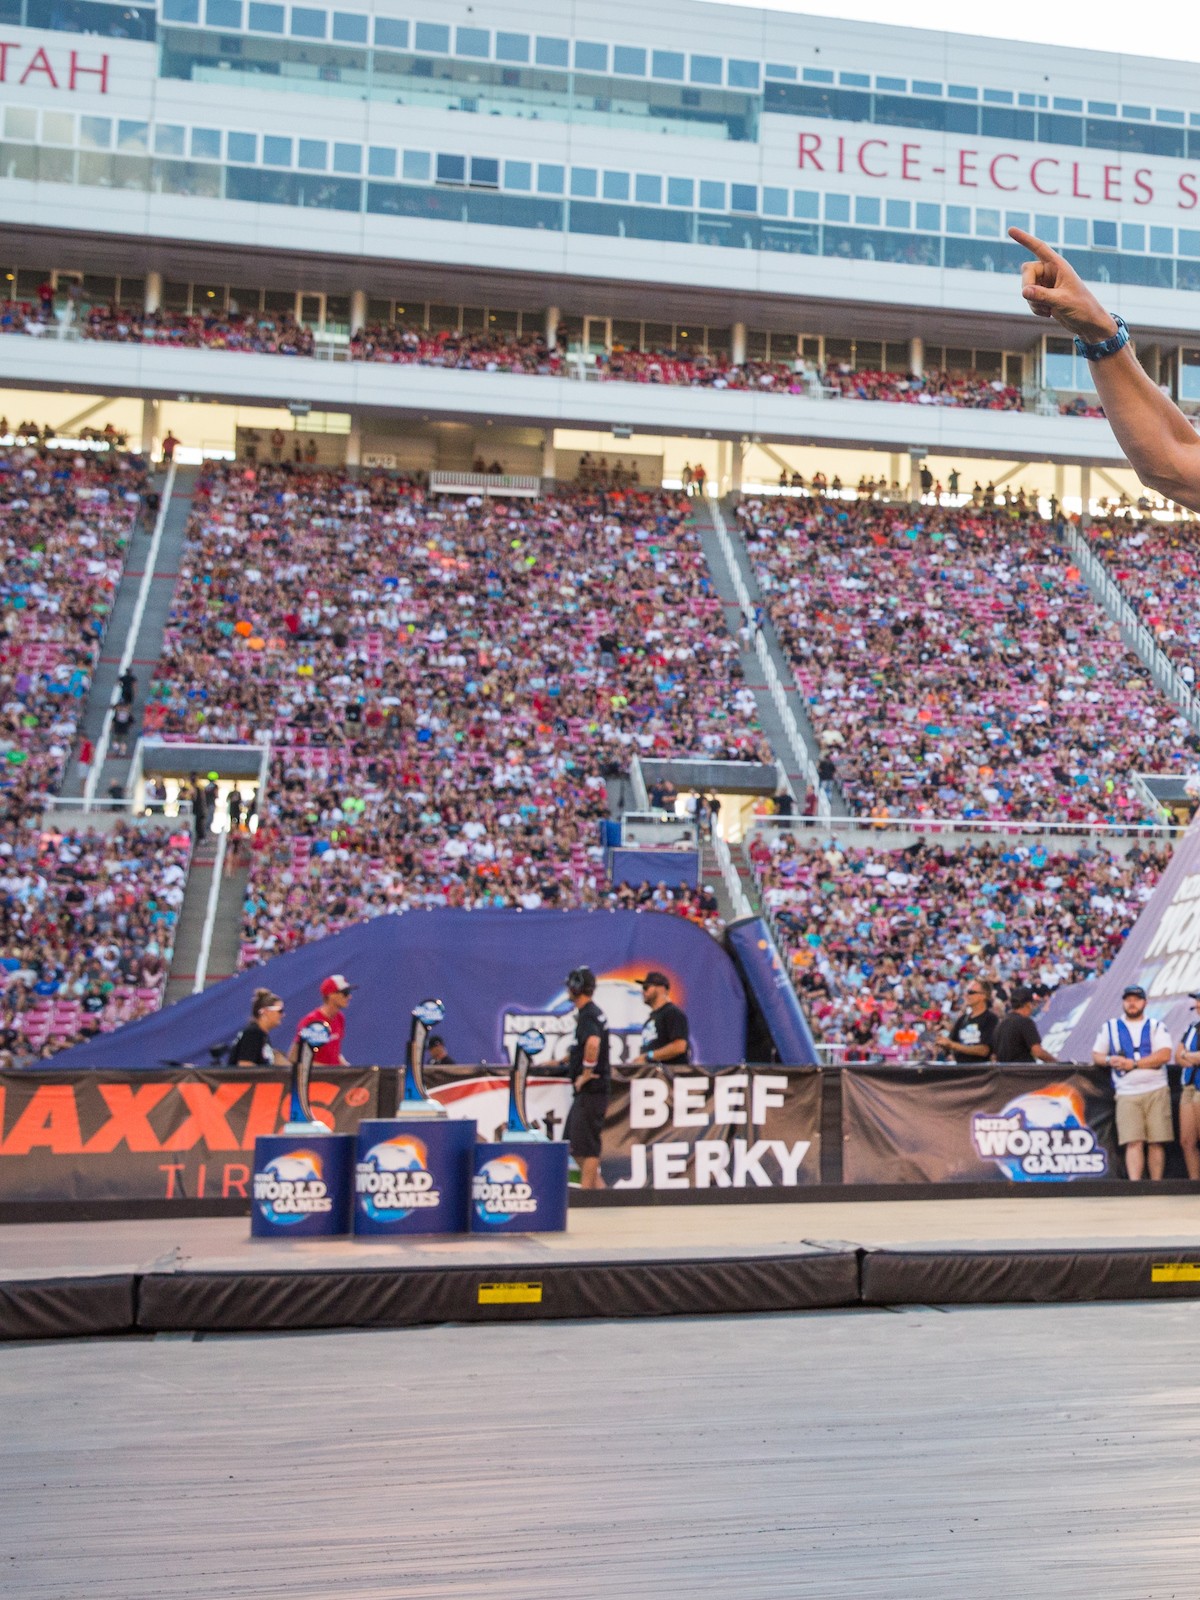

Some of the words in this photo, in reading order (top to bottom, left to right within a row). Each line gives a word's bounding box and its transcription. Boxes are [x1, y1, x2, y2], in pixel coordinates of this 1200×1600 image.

[0, 42, 109, 95] TAH
[797, 132, 1155, 206] RICE-ECCLES
[630, 1073, 789, 1129] BEEF
[0, 1082, 341, 1155] AXXIS
[974, 1129, 1094, 1156] WORLD
[612, 1138, 811, 1190] JERKY
[1022, 1153, 1105, 1174] GAMES
[159, 1163, 250, 1200] TIR
[253, 1181, 328, 1200] WORLD
[355, 1172, 433, 1193] WORLD
[272, 1198, 333, 1214] GAMES
[373, 1191, 440, 1208] GAMES
[484, 1198, 538, 1213] GAMES
